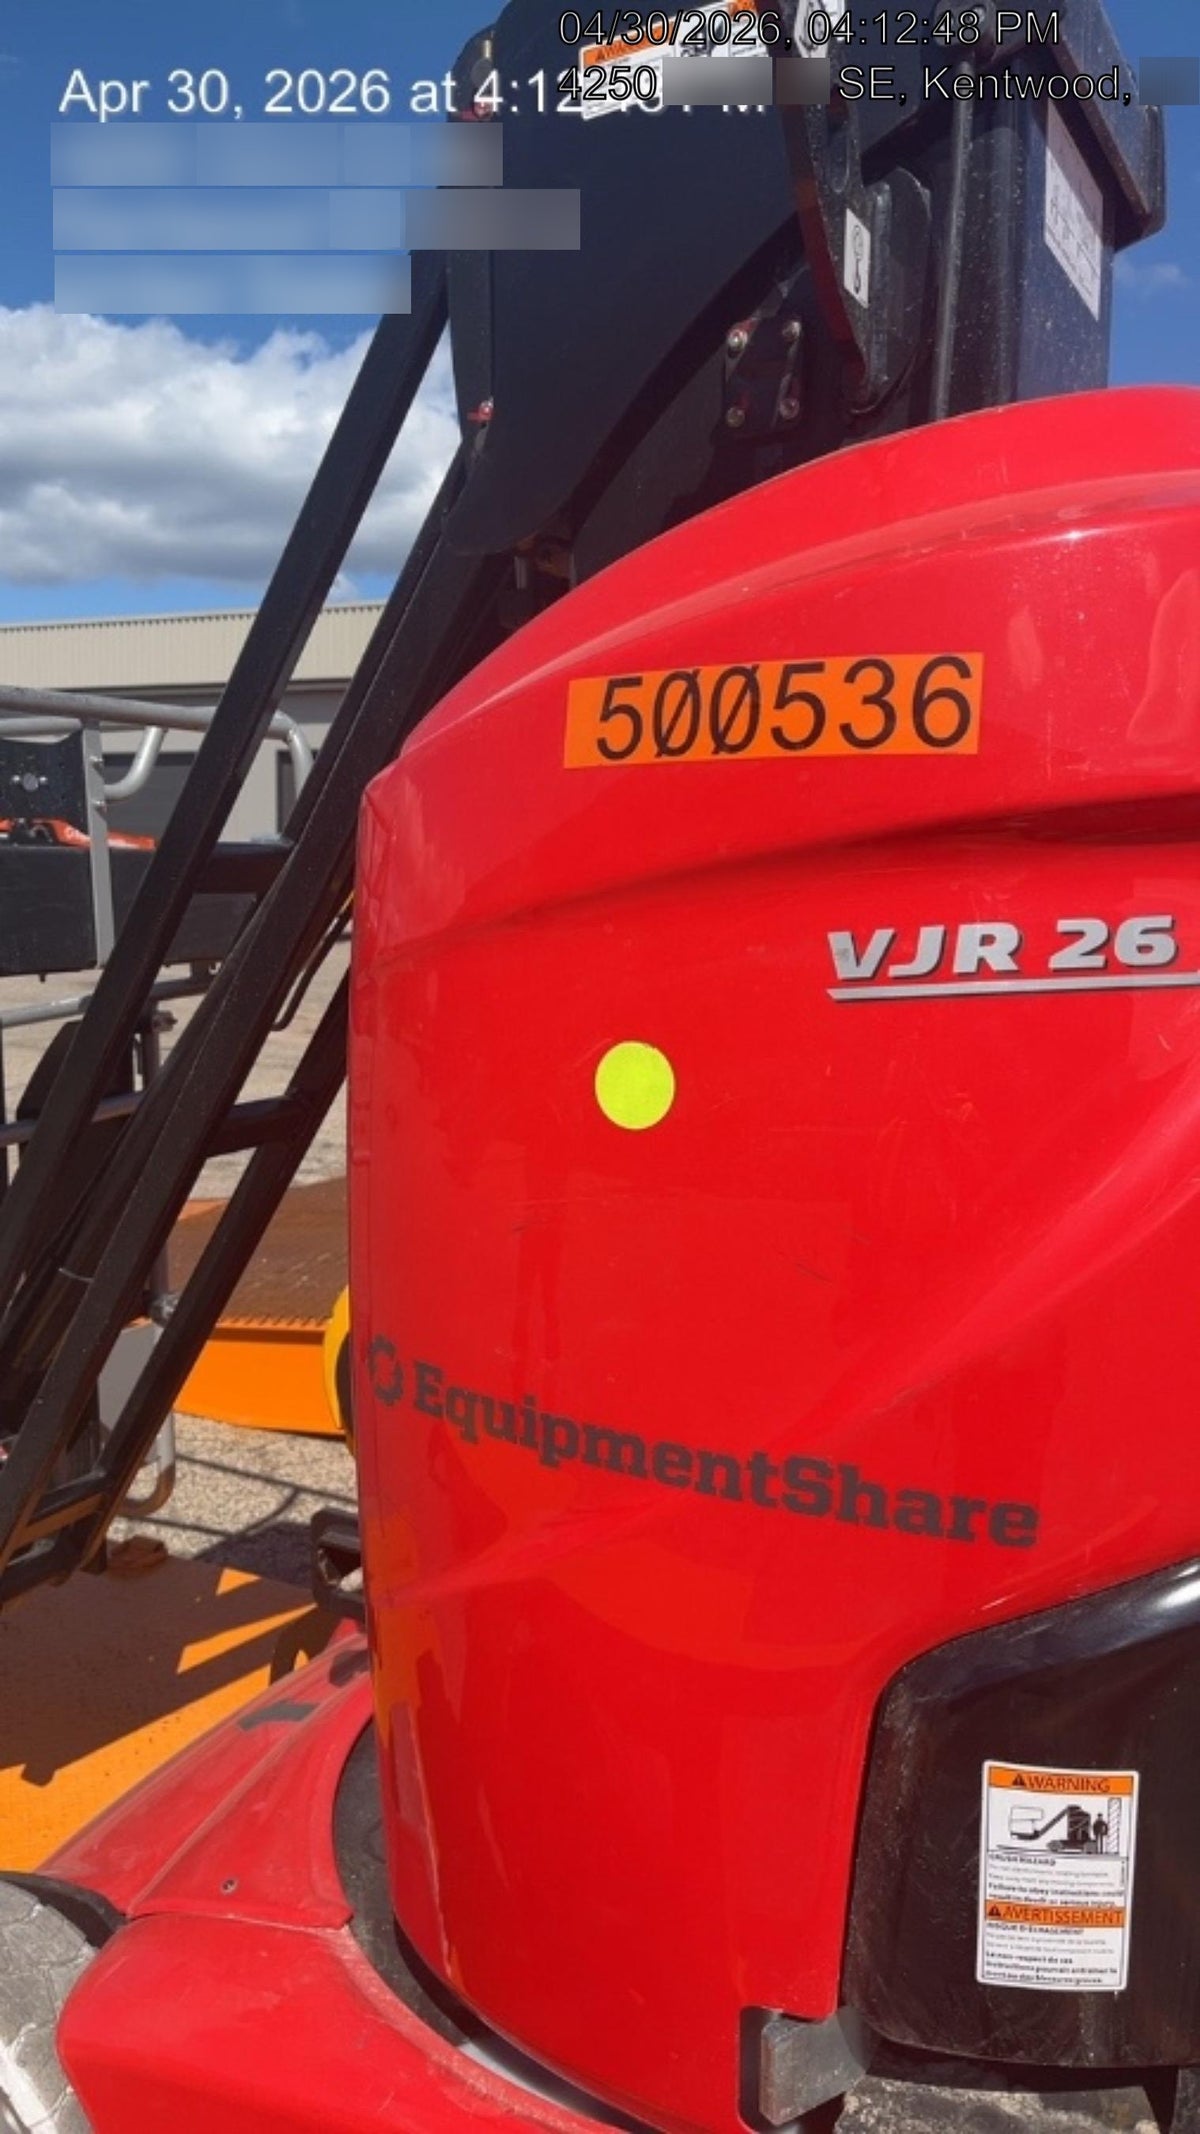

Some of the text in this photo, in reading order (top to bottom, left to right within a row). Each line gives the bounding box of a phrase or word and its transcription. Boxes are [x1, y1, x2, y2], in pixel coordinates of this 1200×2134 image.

[597, 655, 973, 761] 500536
[827, 914, 1179, 981] VJR 26
[412, 1358, 1041, 1549] EquipmentShare
[1028, 1775, 1111, 1793] WARNING
[1002, 1906, 1123, 1925] AVERTISSEMENT
